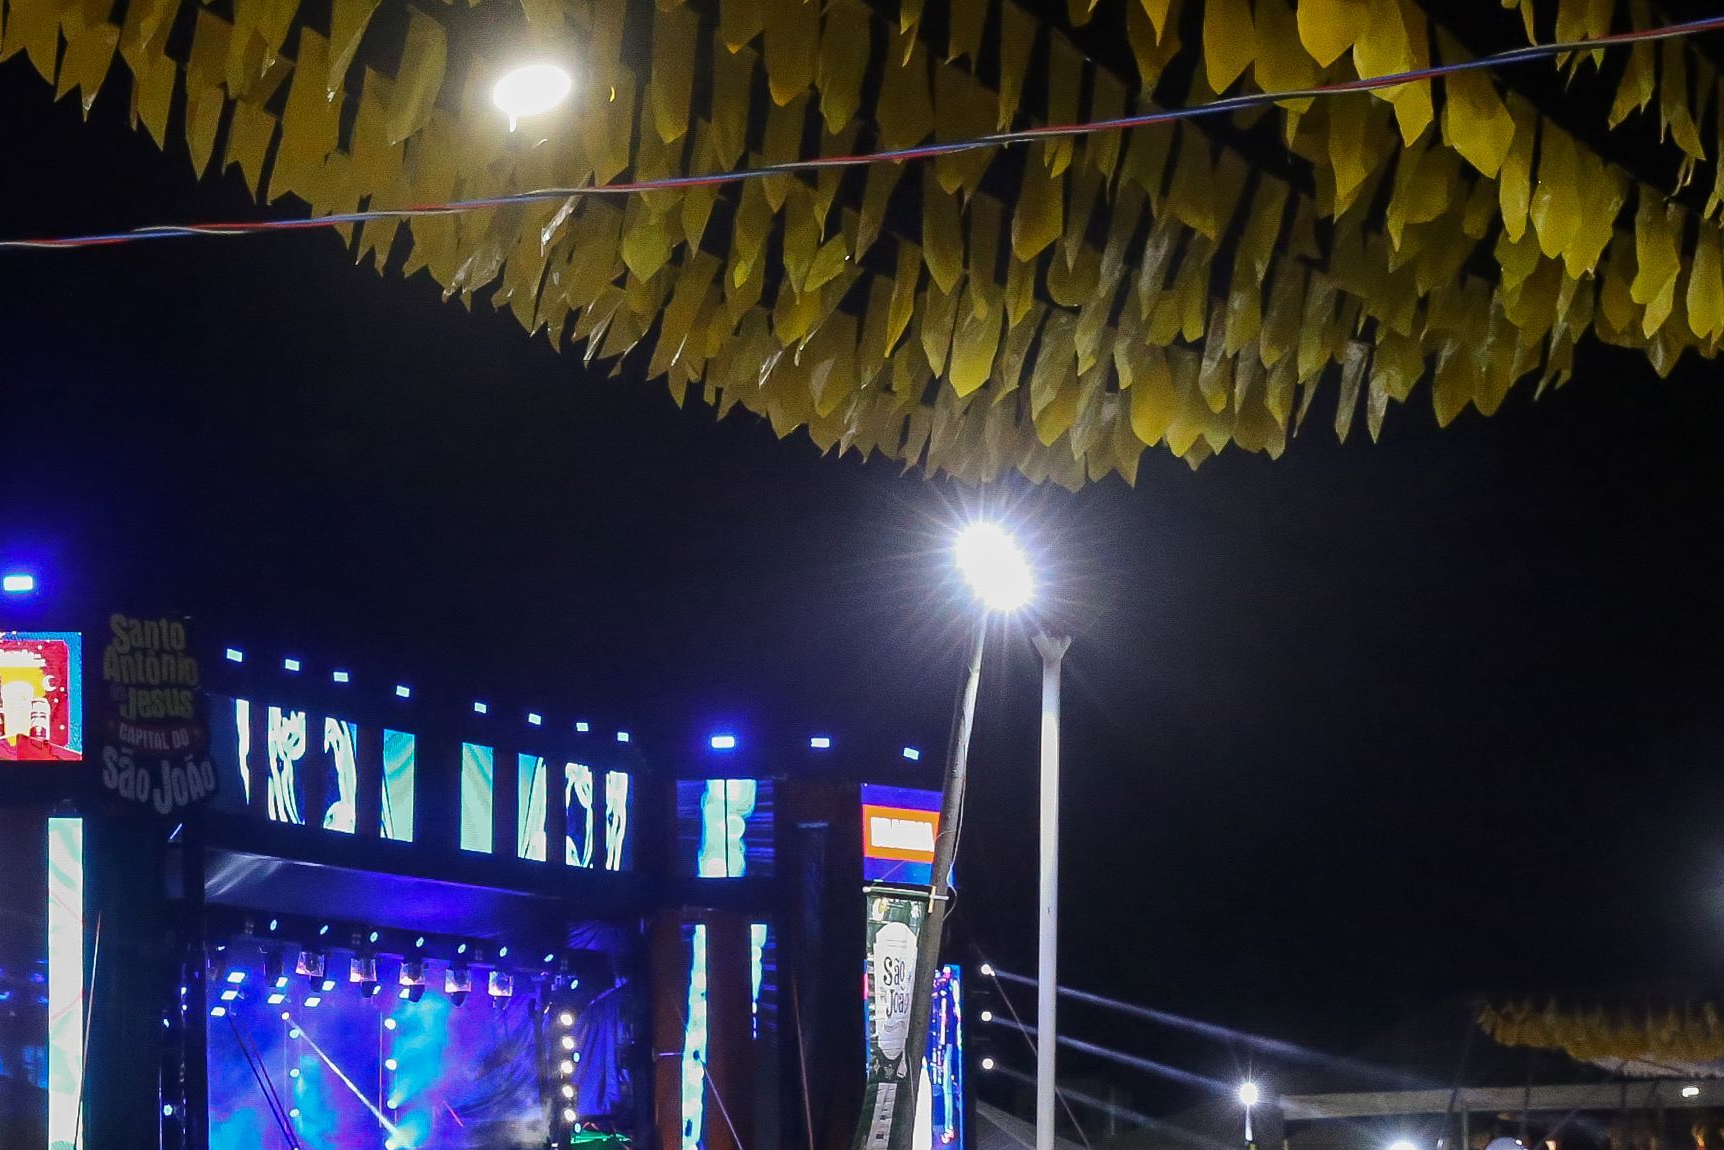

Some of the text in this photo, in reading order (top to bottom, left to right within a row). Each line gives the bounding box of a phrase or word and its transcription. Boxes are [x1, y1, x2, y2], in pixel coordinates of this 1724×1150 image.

[110, 613, 186, 654] Santo
[119, 722, 170, 750] CAPITAL
[102, 745, 150, 803] São
[883, 956, 905, 986] São
[886, 986, 910, 1019] João
